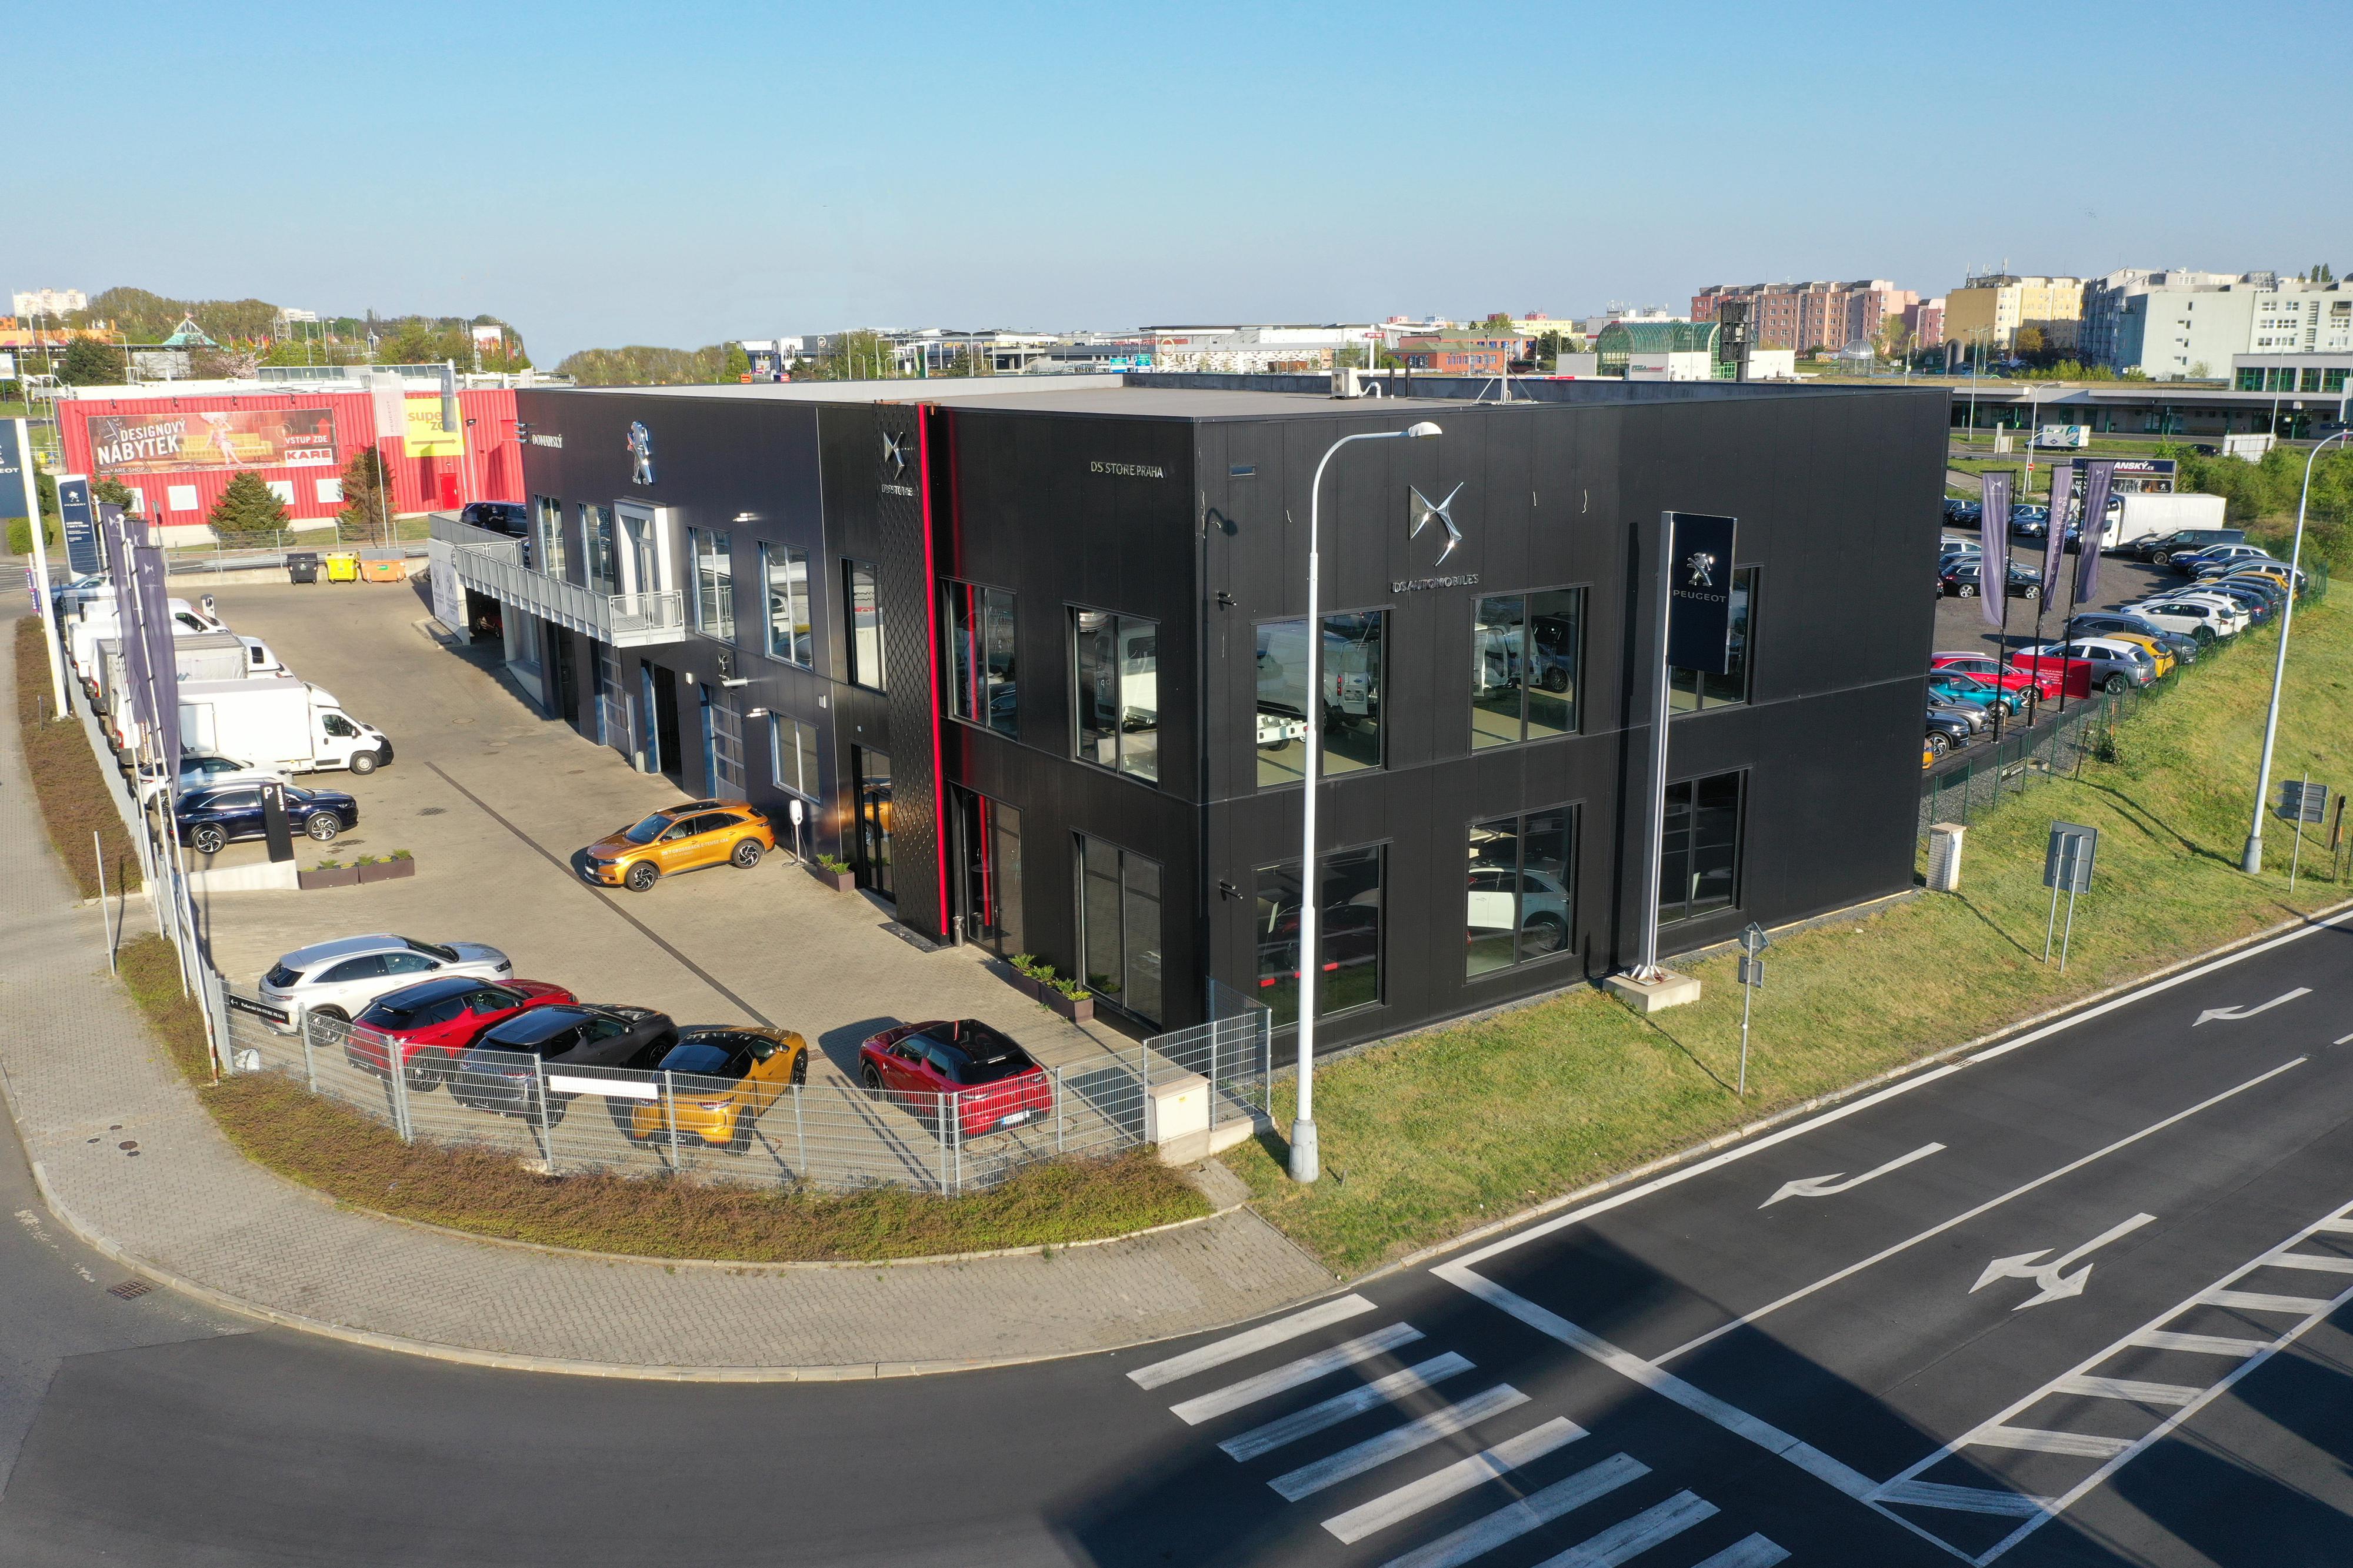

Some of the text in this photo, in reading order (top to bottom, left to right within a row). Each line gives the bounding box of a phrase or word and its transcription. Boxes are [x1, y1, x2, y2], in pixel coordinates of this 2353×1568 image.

[408, 411, 442, 423] supe
[120, 417, 186, 442] DESIGNOVÝ
[285, 436, 311, 445] VSTUP
[532, 433, 562, 449] DOMANSKÝ
[96, 435, 180, 465] NÁBYTEK
[286, 449, 331, 460] KARE
[1091, 461, 1164, 479] DS STORE PRAHA
[2114, 461, 2155, 471] ANSKÝ.cz
[1407, 573, 1479, 591] AUTOMOBILES
[1672, 589, 1727, 603] PEUGEOT
[264, 786, 273, 800] P
